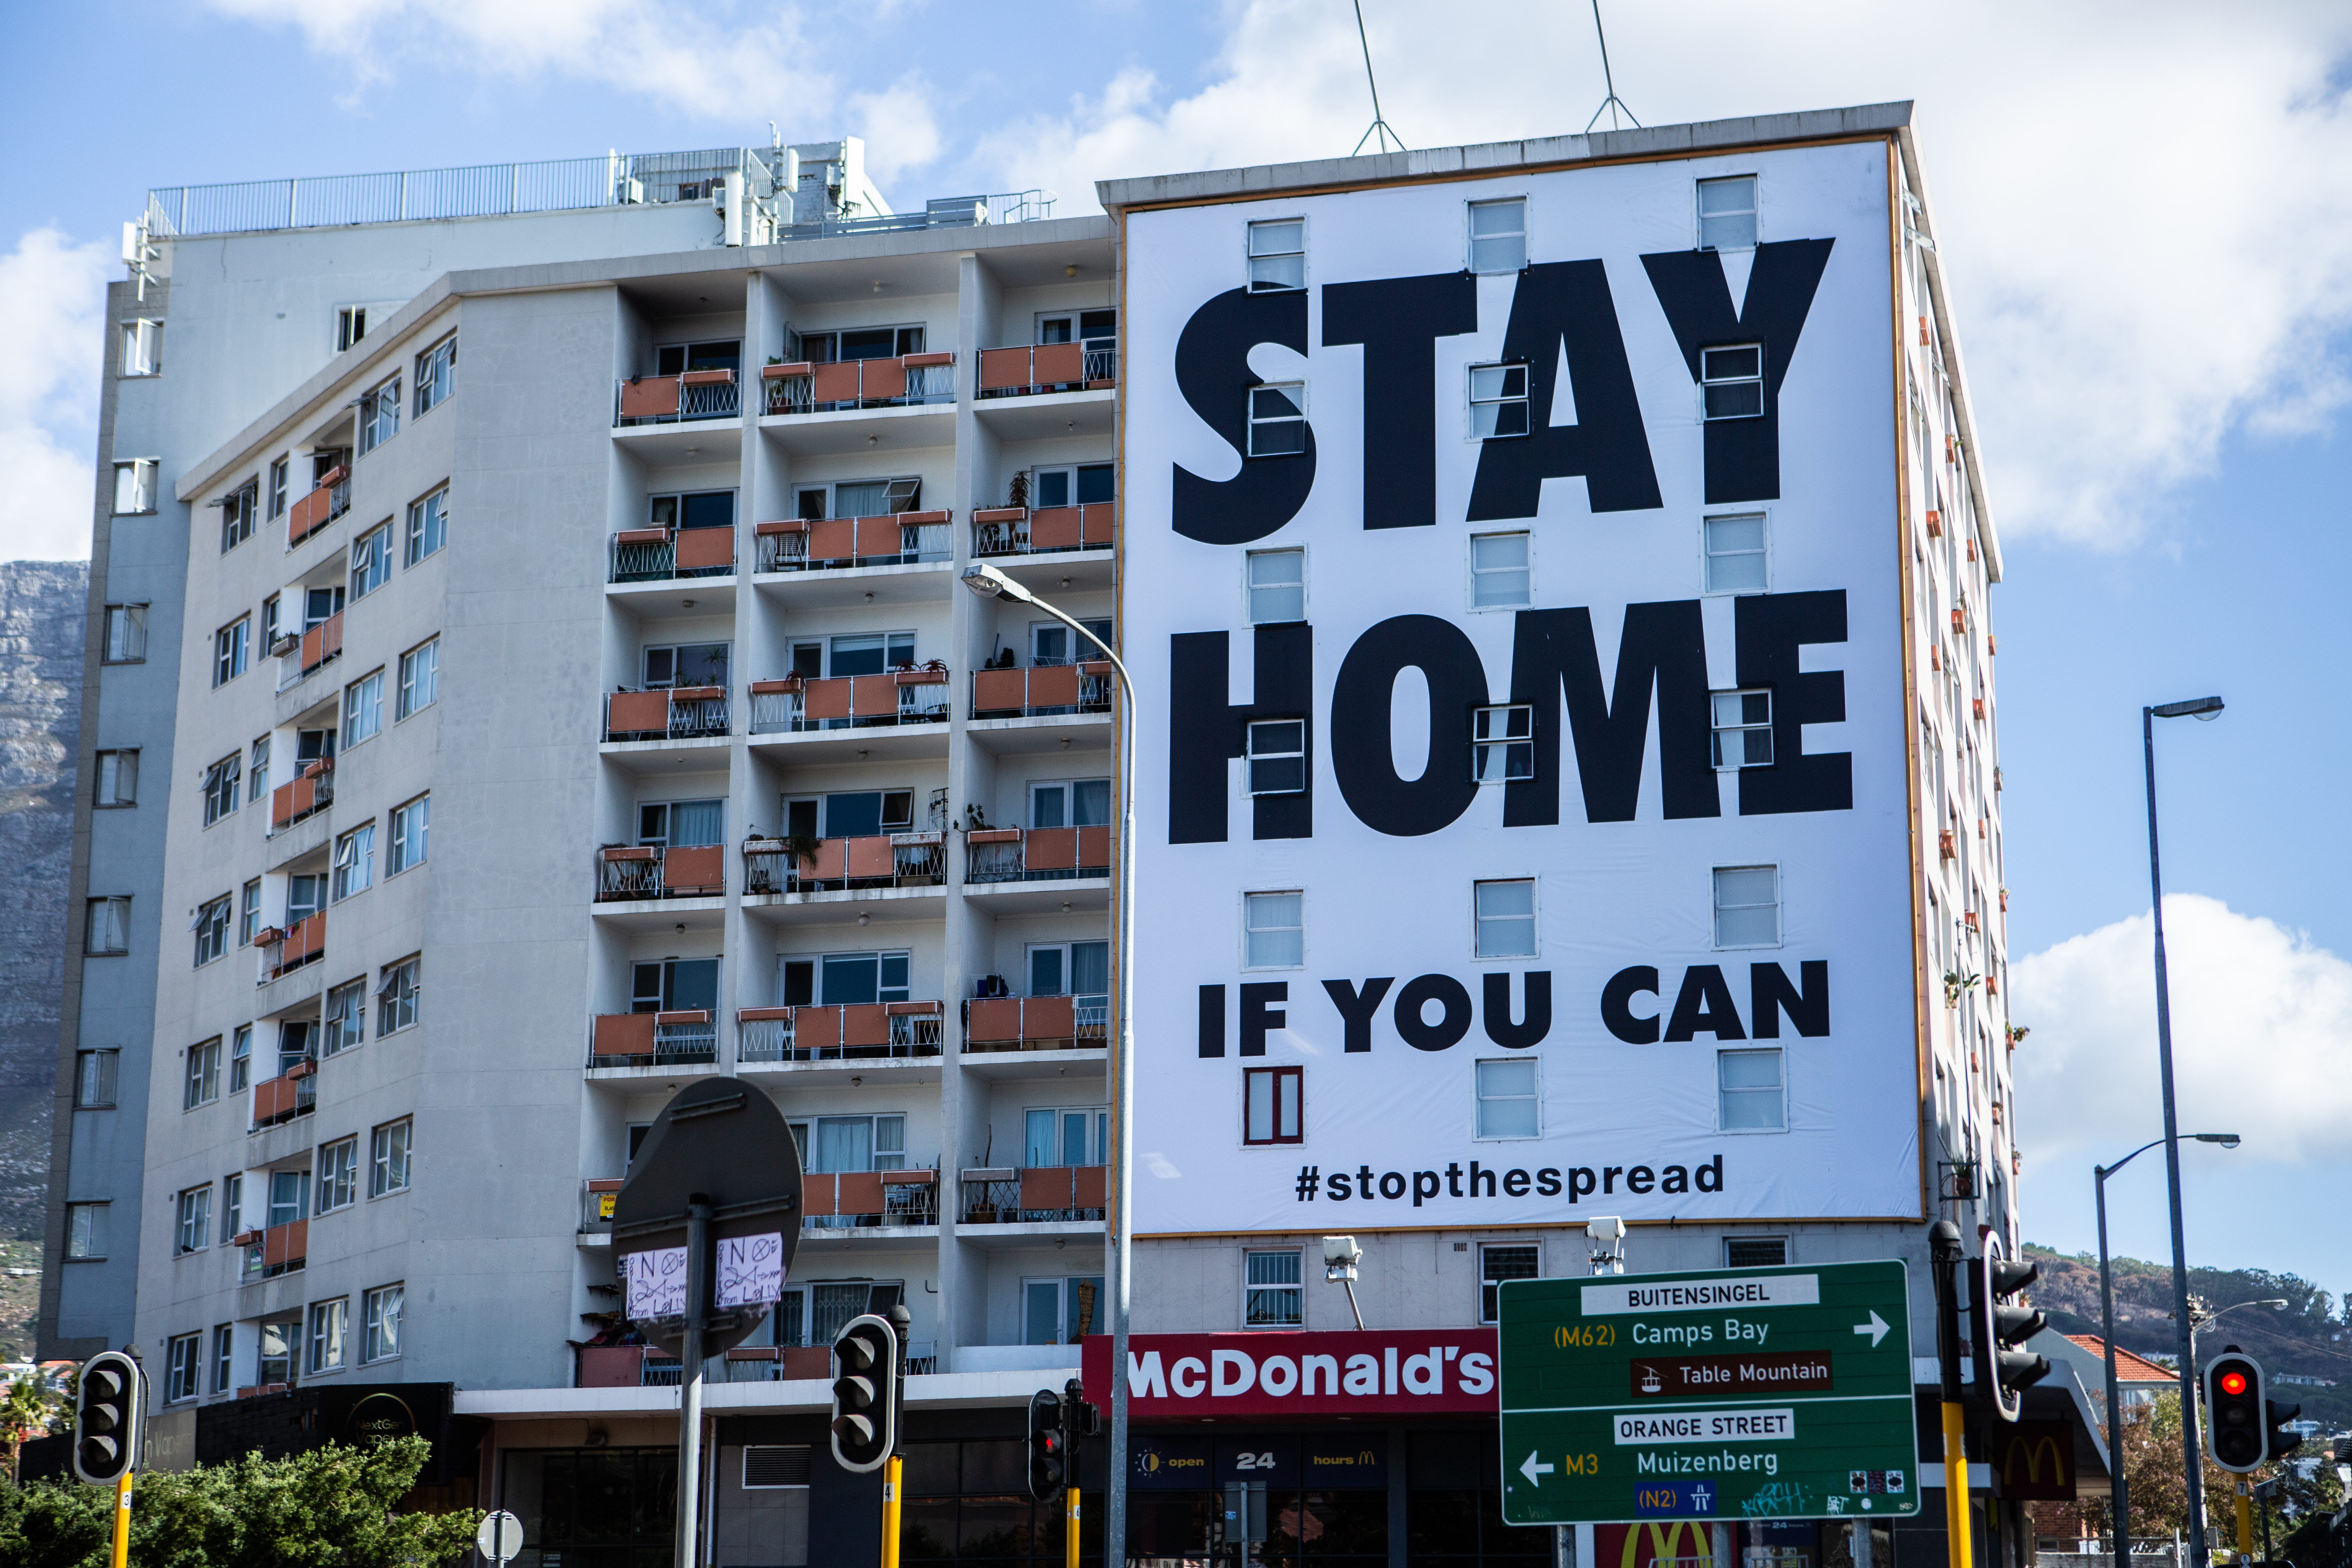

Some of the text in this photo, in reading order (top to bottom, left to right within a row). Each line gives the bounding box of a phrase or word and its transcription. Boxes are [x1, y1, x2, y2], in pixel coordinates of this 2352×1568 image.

[1172, 237, 1836, 545] STAY
[1168, 589, 1853, 845] HOME
[1199, 960, 1830, 1058] IF YOU CAN
[1296, 1154, 1724, 1207] #stopthespread
[1628, 1283, 1771, 1307] BUITENSINGEL
[1555, 1319, 1769, 1349] (M62) Camps Bay
[1110, 1346, 1494, 1398] McDonald's
[1679, 1361, 1828, 1384] Table Mountain
[356, 1419, 404, 1430] NextGen
[1620, 1415, 1787, 1438] ORANGE STREET
[1168, 1456, 1204, 1468] open
[1236, 1452, 1276, 1469] 24
[1313, 1454, 1354, 1466] hours
[1566, 1450, 1778, 1475] M3 Muizenberg
[885, 1485, 891, 1498] 4
[1639, 1489, 1677, 1510] (N2)
[2239, 1483, 2245, 1493] 7
[124, 1495, 129, 1506] 3
